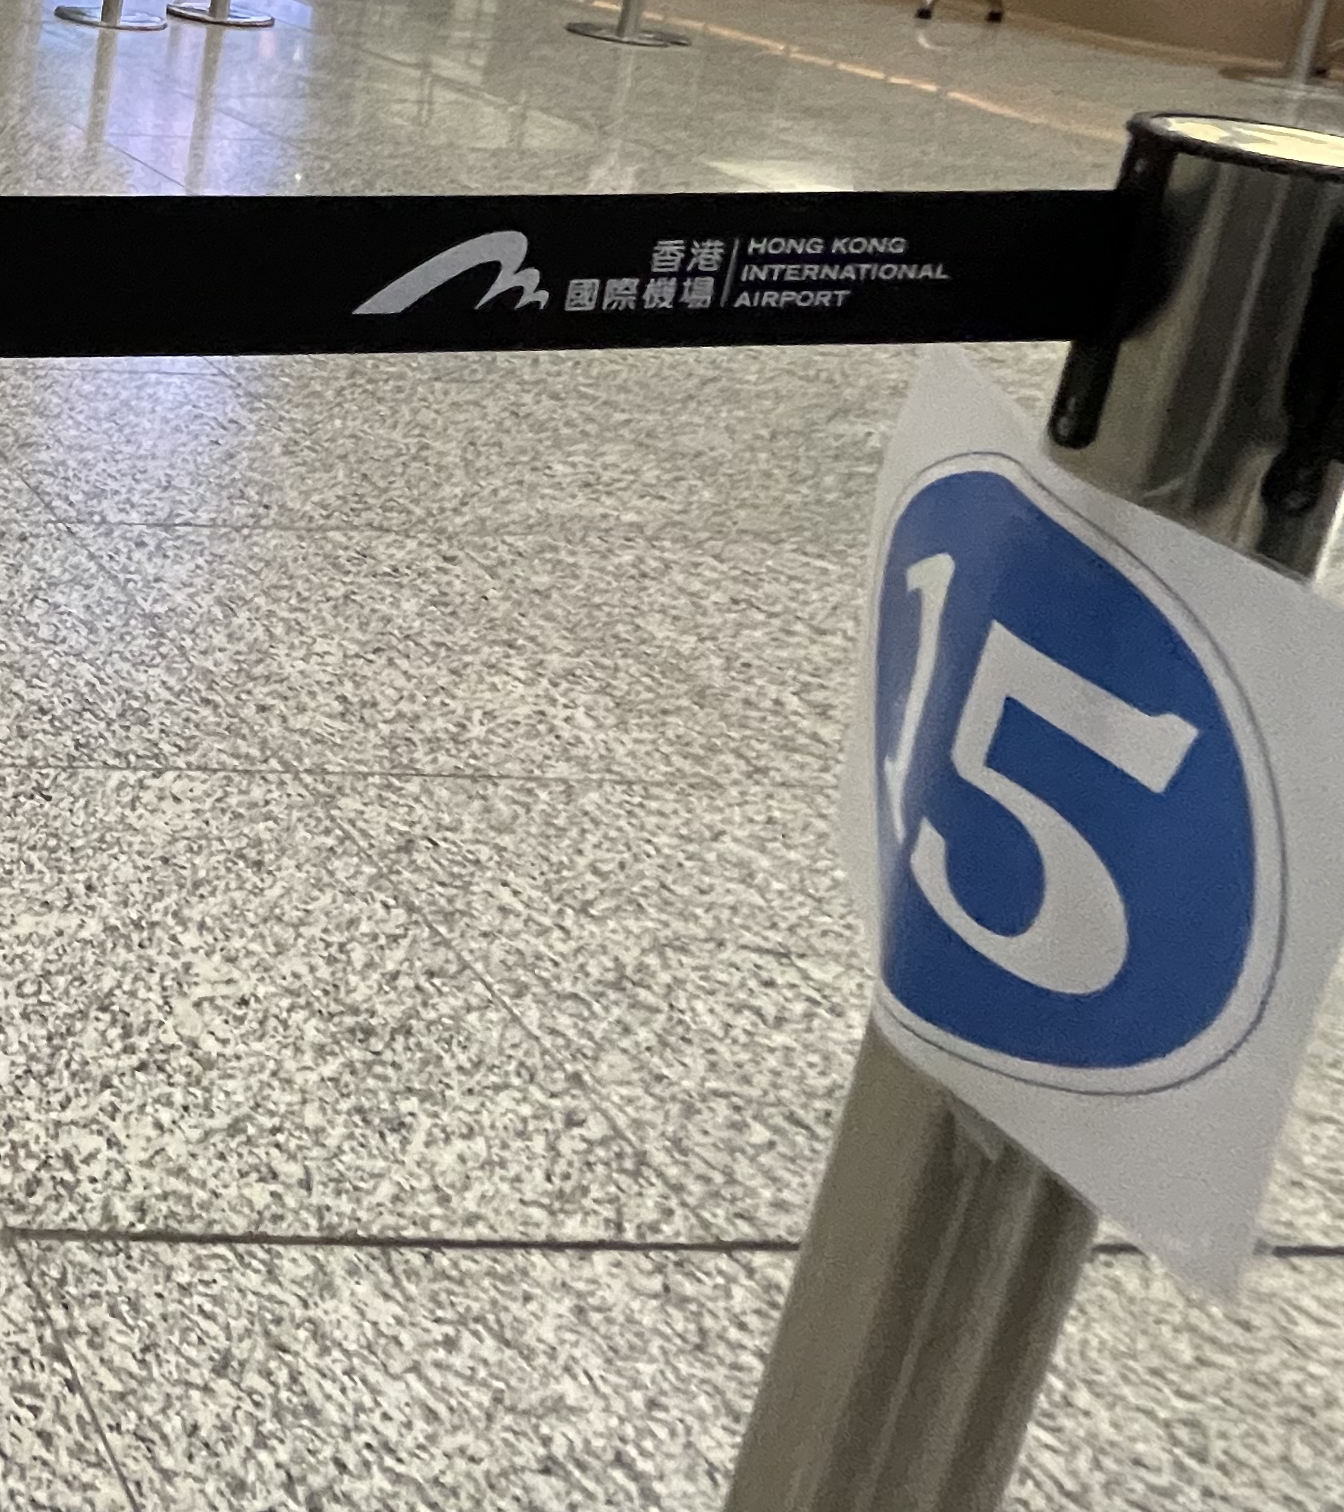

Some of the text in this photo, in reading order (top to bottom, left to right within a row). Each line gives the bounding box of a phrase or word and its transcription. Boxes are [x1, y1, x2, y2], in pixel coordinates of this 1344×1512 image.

[747, 237, 908, 255] HONG KONG
[651, 239, 724, 273] 香港
[739, 263, 950, 282] INTERNATIONAL
[733, 289, 852, 308] AIRPORT
[883, 550, 1202, 996] 15
